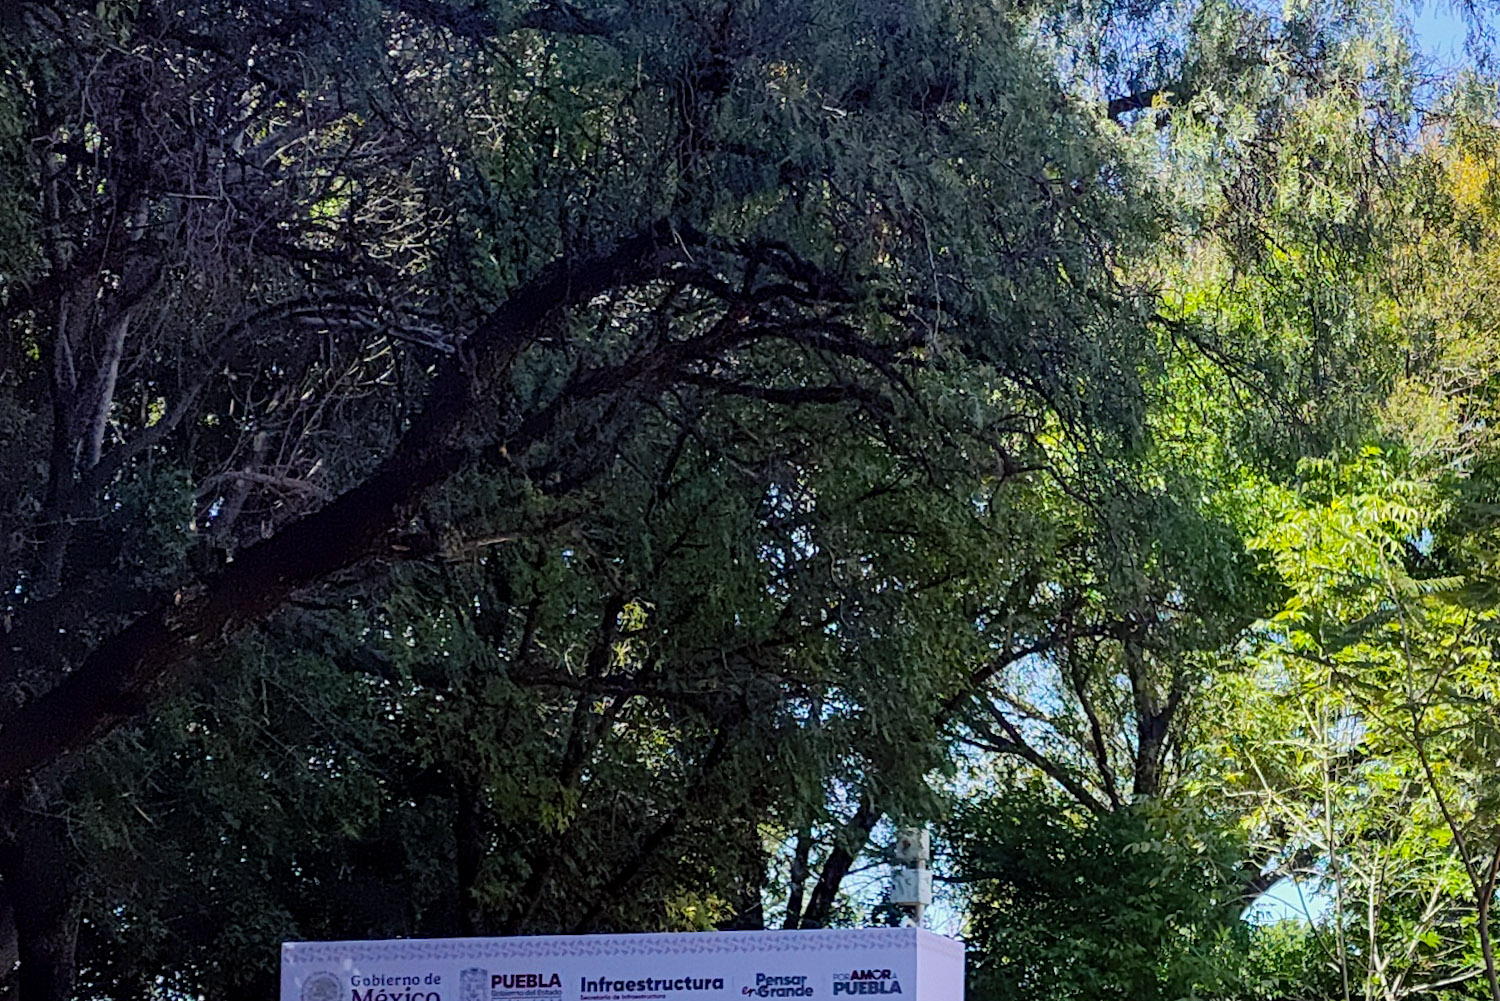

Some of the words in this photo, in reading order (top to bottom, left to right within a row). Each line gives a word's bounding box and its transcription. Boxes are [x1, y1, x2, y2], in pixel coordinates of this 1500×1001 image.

[351, 974, 420, 986] Gobierno
[425, 973, 441, 985] de
[491, 973, 562, 989] PUEBLA
[756, 972, 807, 986] Pensar
[850, 969, 891, 980] AMOR
[581, 976, 724, 992] Infraestructura
[833, 981, 903, 996] PUEBLA
[757, 985, 814, 998] Grande
